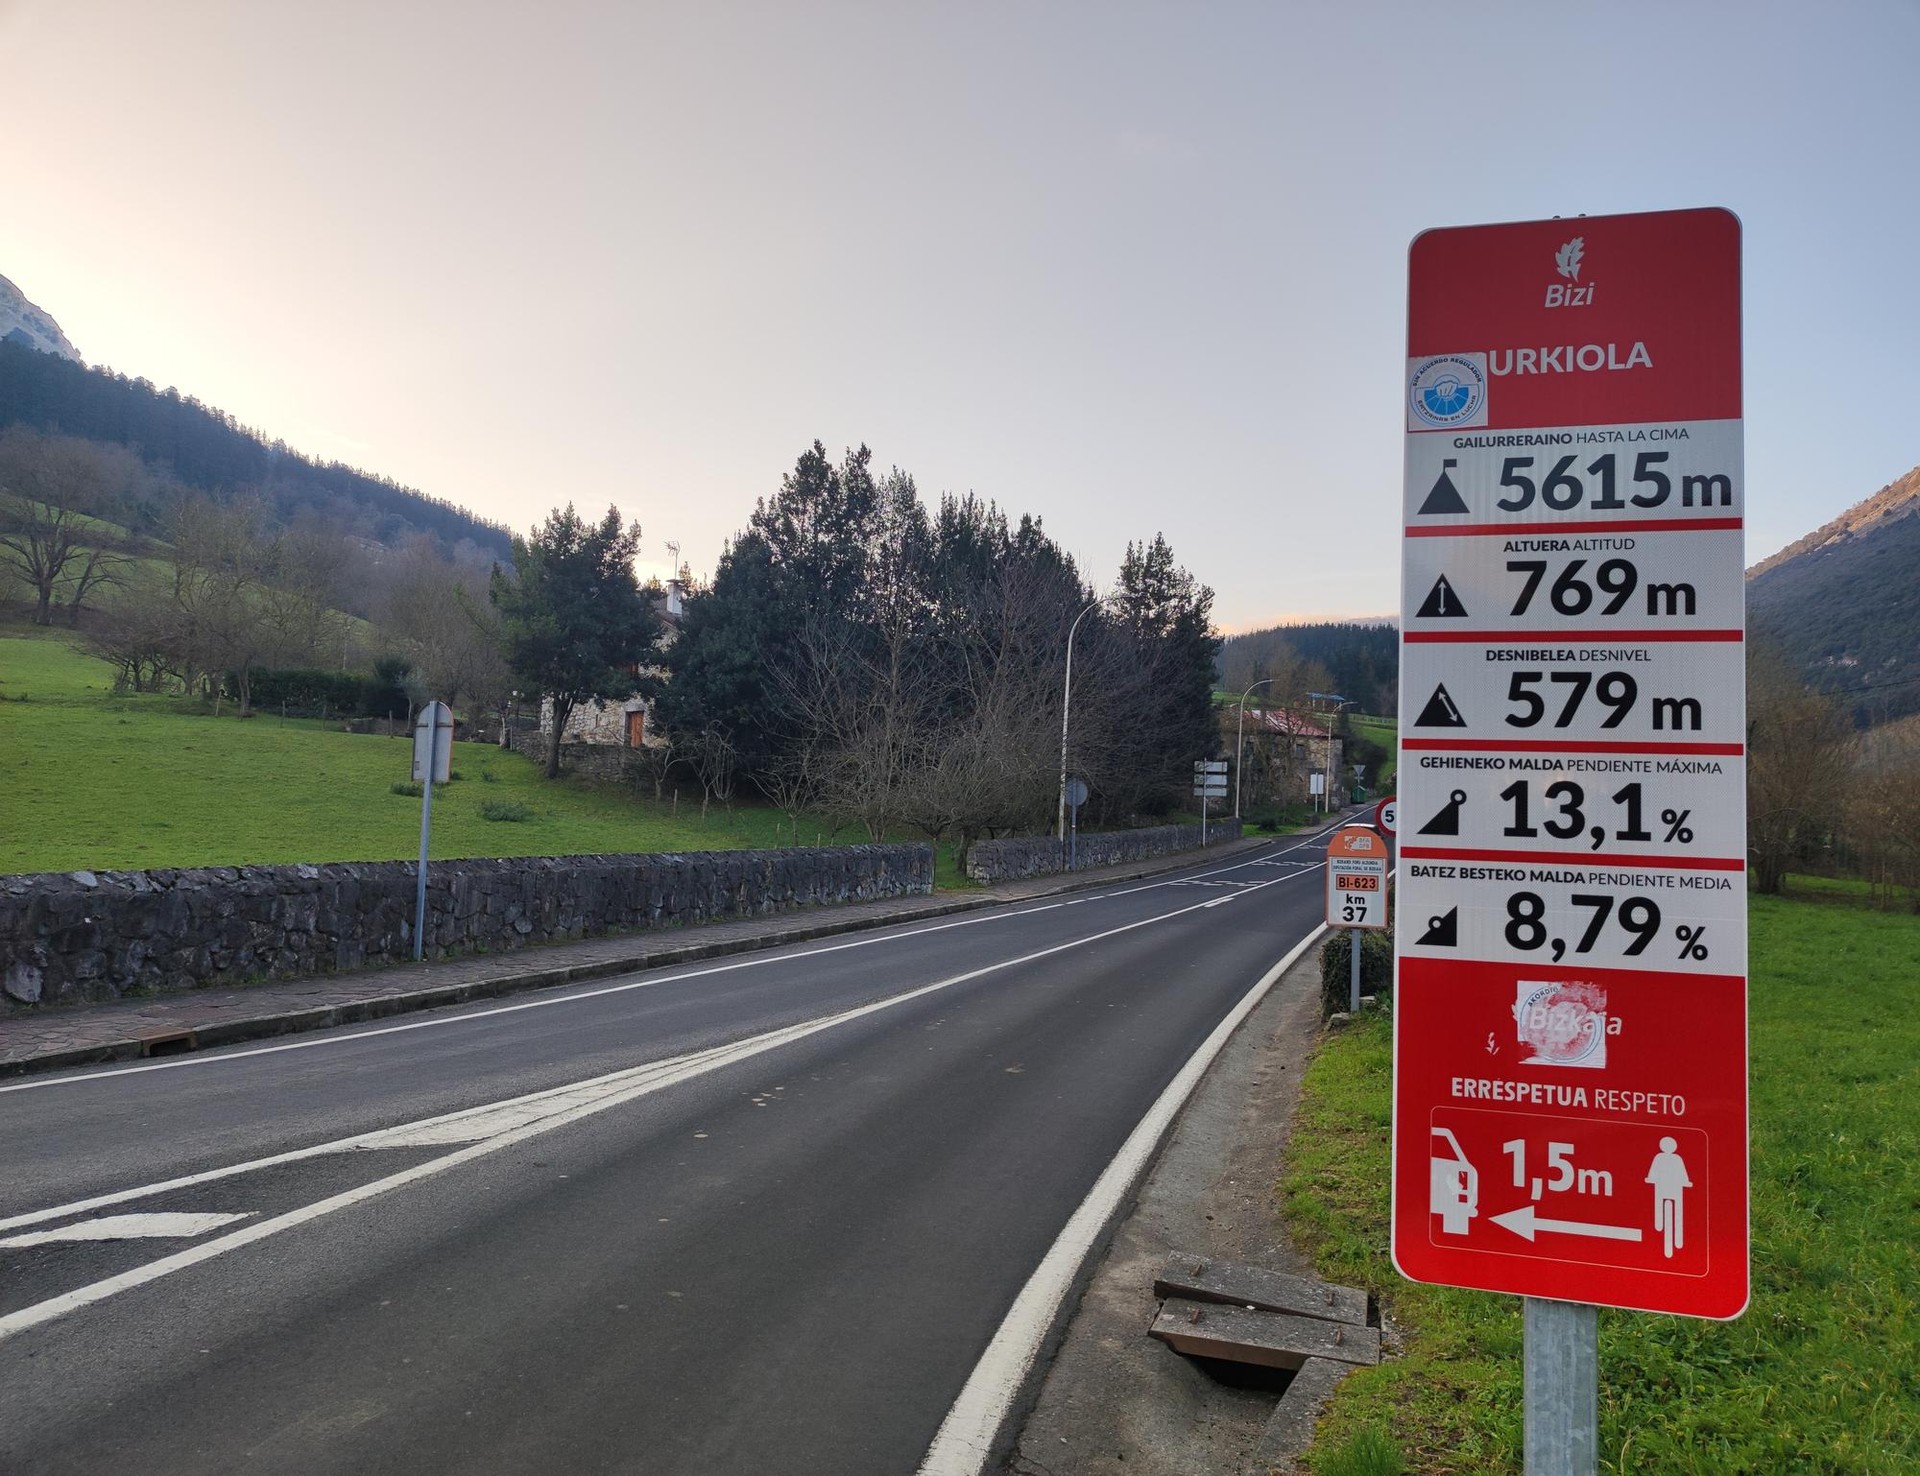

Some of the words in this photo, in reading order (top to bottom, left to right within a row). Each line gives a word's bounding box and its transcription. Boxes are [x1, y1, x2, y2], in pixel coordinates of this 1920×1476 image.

[1545, 282, 1595, 308] Bizi
[1489, 342, 1653, 376] URKIOLA
[1453, 433, 1573, 449] GAILURRERAINO
[1577, 431, 1625, 444] HASTA
[1628, 430, 1647, 442] LA
[1649, 428, 1690, 441] CIMA
[1496, 451, 1671, 512] 5615
[1503, 539, 1570, 553] ALTUERA
[1573, 538, 1635, 551] ALTITUD
[1486, 649, 1576, 662] DESNIBELEA
[1579, 650, 1651, 662] DESNIVEL
[1504, 671, 1638, 729] 579
[1420, 757, 1505, 770] GEHIENEKO
[1509, 758, 1564, 771] MALDA
[1567, 760, 1651, 773] PENDIENTE
[1656, 759, 1722, 775] MÁXIMA
[1385, 810, 1396, 823] 5
[1338, 877, 1376, 889] BI-623
[1411, 865, 1456, 879] BATEZ
[1459, 866, 1526, 881] BESTEKO
[1529, 869, 1585, 884] MALDA
[1589, 872, 1674, 888] PENDIENTE
[1679, 875, 1732, 890] MEDIA
[1346, 893, 1365, 904] km
[1342, 906, 1367, 923] 37
[1451, 1078, 1587, 1108] ERRESPETUA
[1595, 1089, 1686, 1116] RESPETO
